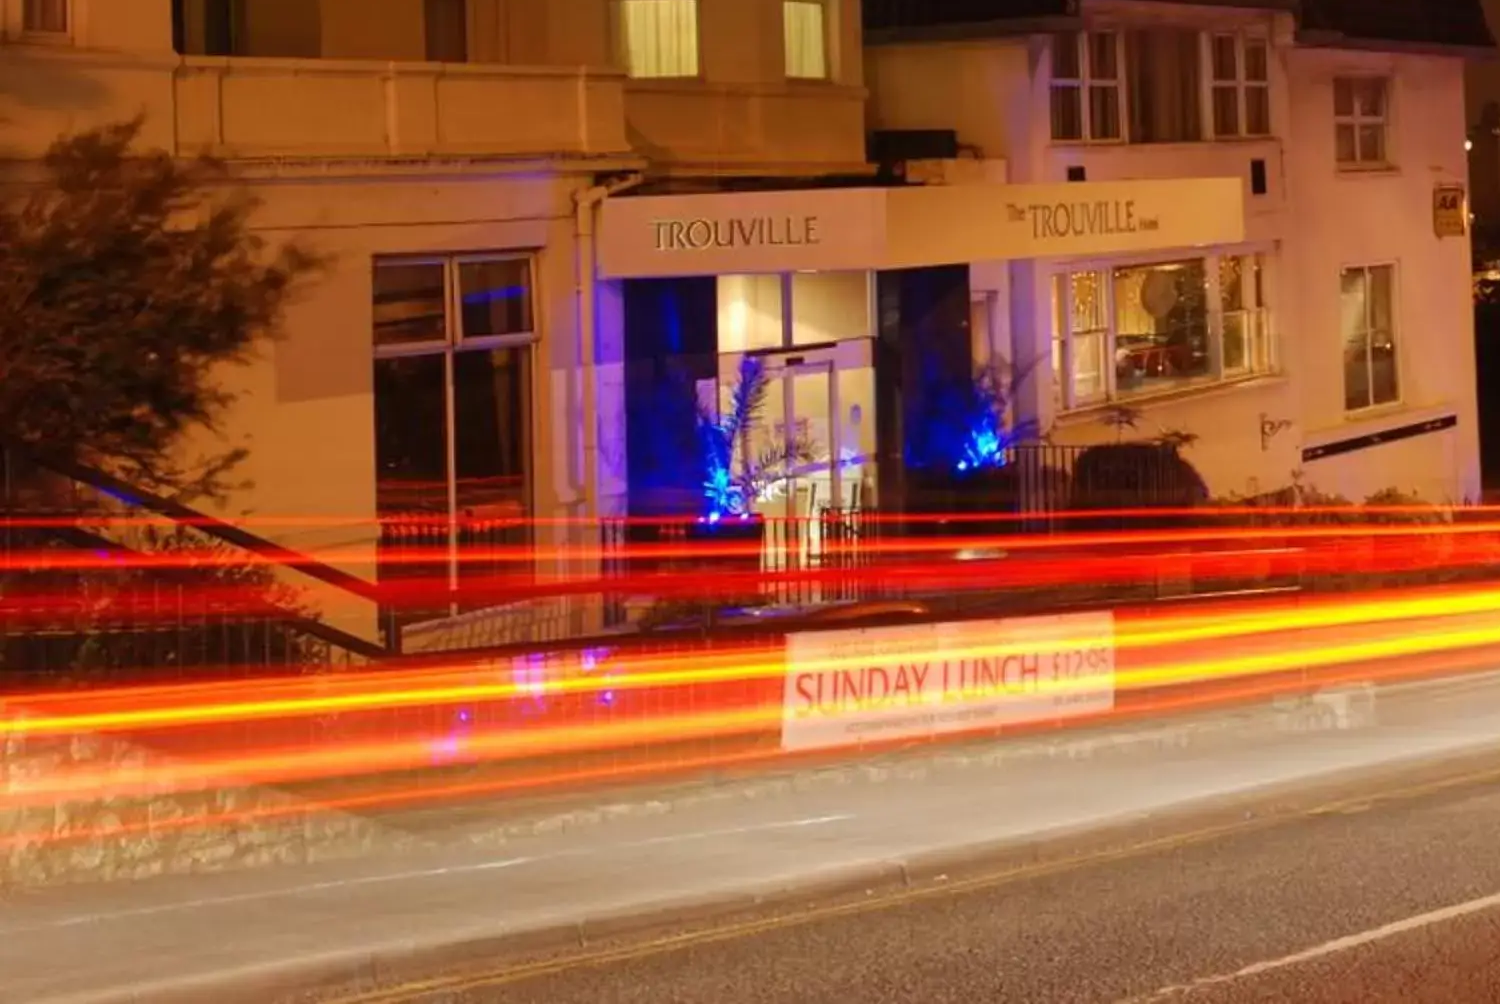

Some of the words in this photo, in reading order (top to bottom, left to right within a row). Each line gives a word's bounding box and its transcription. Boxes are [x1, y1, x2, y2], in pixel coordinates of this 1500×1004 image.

[1028, 199, 1136, 239] TROUVILLE
[1439, 194, 1458, 210] AA
[652, 216, 821, 249] TROUVILLE
[795, 661, 930, 717] SUNDAY
[942, 652, 1040, 702] LUNCH
